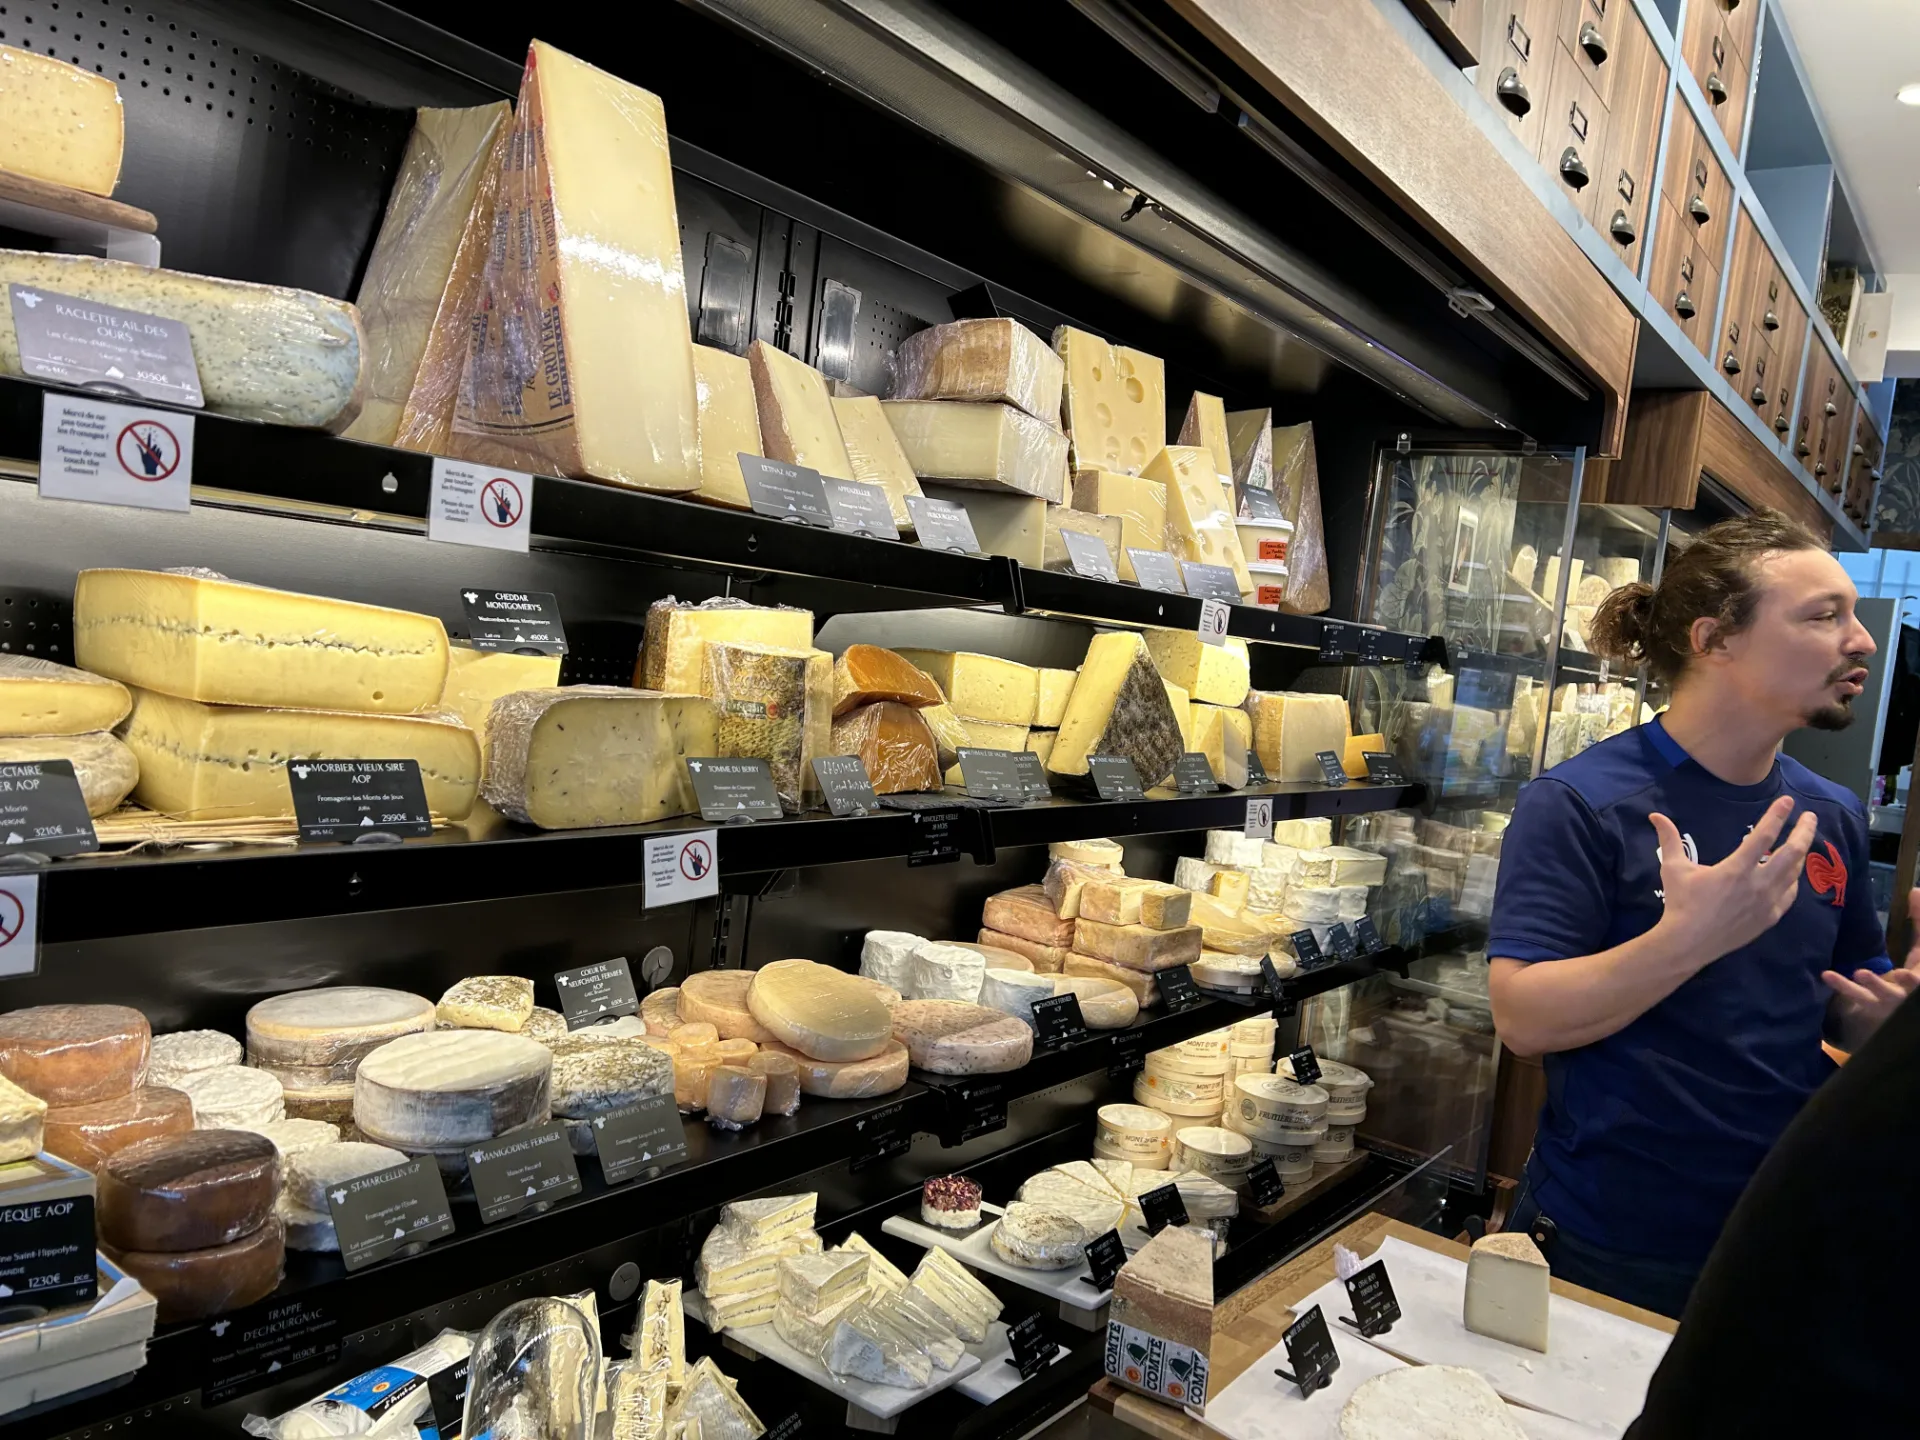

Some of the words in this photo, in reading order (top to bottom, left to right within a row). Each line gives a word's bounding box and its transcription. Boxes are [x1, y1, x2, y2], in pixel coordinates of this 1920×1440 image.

[55, 304, 121, 327] RACLETTE
[144, 324, 168, 338] DES
[97, 327, 133, 342] OURS
[547, 387, 563, 410] LE
[76, 420, 106, 431] toucher
[69, 428, 104, 441] fromages
[57, 445, 82, 454] Please
[82, 448, 93, 456] do
[63, 457, 86, 466] touch
[87, 458, 100, 467] the
[495, 592, 529, 602] CHEDDAR
[485, 601, 542, 612] MONTGOMERY'S
[310, 763, 355, 772] MORBIER
[356, 763, 384, 772] VIEUX
[385, 763, 406, 772] SIRE
[708, 765, 731, 773] TOMME
[732, 765, 741, 773] DU
[352, 774, 372, 784] AOP
[15, 779, 41, 791] AOP
[317, 795, 352, 803] Fromagerie
[416, 815, 425, 823] kg
[76, 826, 87, 835] kg
[580, 966, 599, 977] COEUR
[599, 964, 608, 972] DE
[601, 969, 624, 980] FERMIER
[481, 1141, 530, 1162] MANIGODINE
[530, 1131, 561, 1148] FERMIER
[350, 1169, 408, 1193] ST-MARCELLIN
[408, 1163, 421, 1175] IGP
[45, 1202, 74, 1217] AOP
[349, 1242, 360, 1251] Lait
[28, 1274, 61, 1289] 1230€
[73, 1273, 90, 1283] pce
[268, 1302, 303, 1321] TRAPPE
[243, 1308, 323, 1342] D'ECHOURGNAC
[1190, 1352, 1206, 1405] COMT
